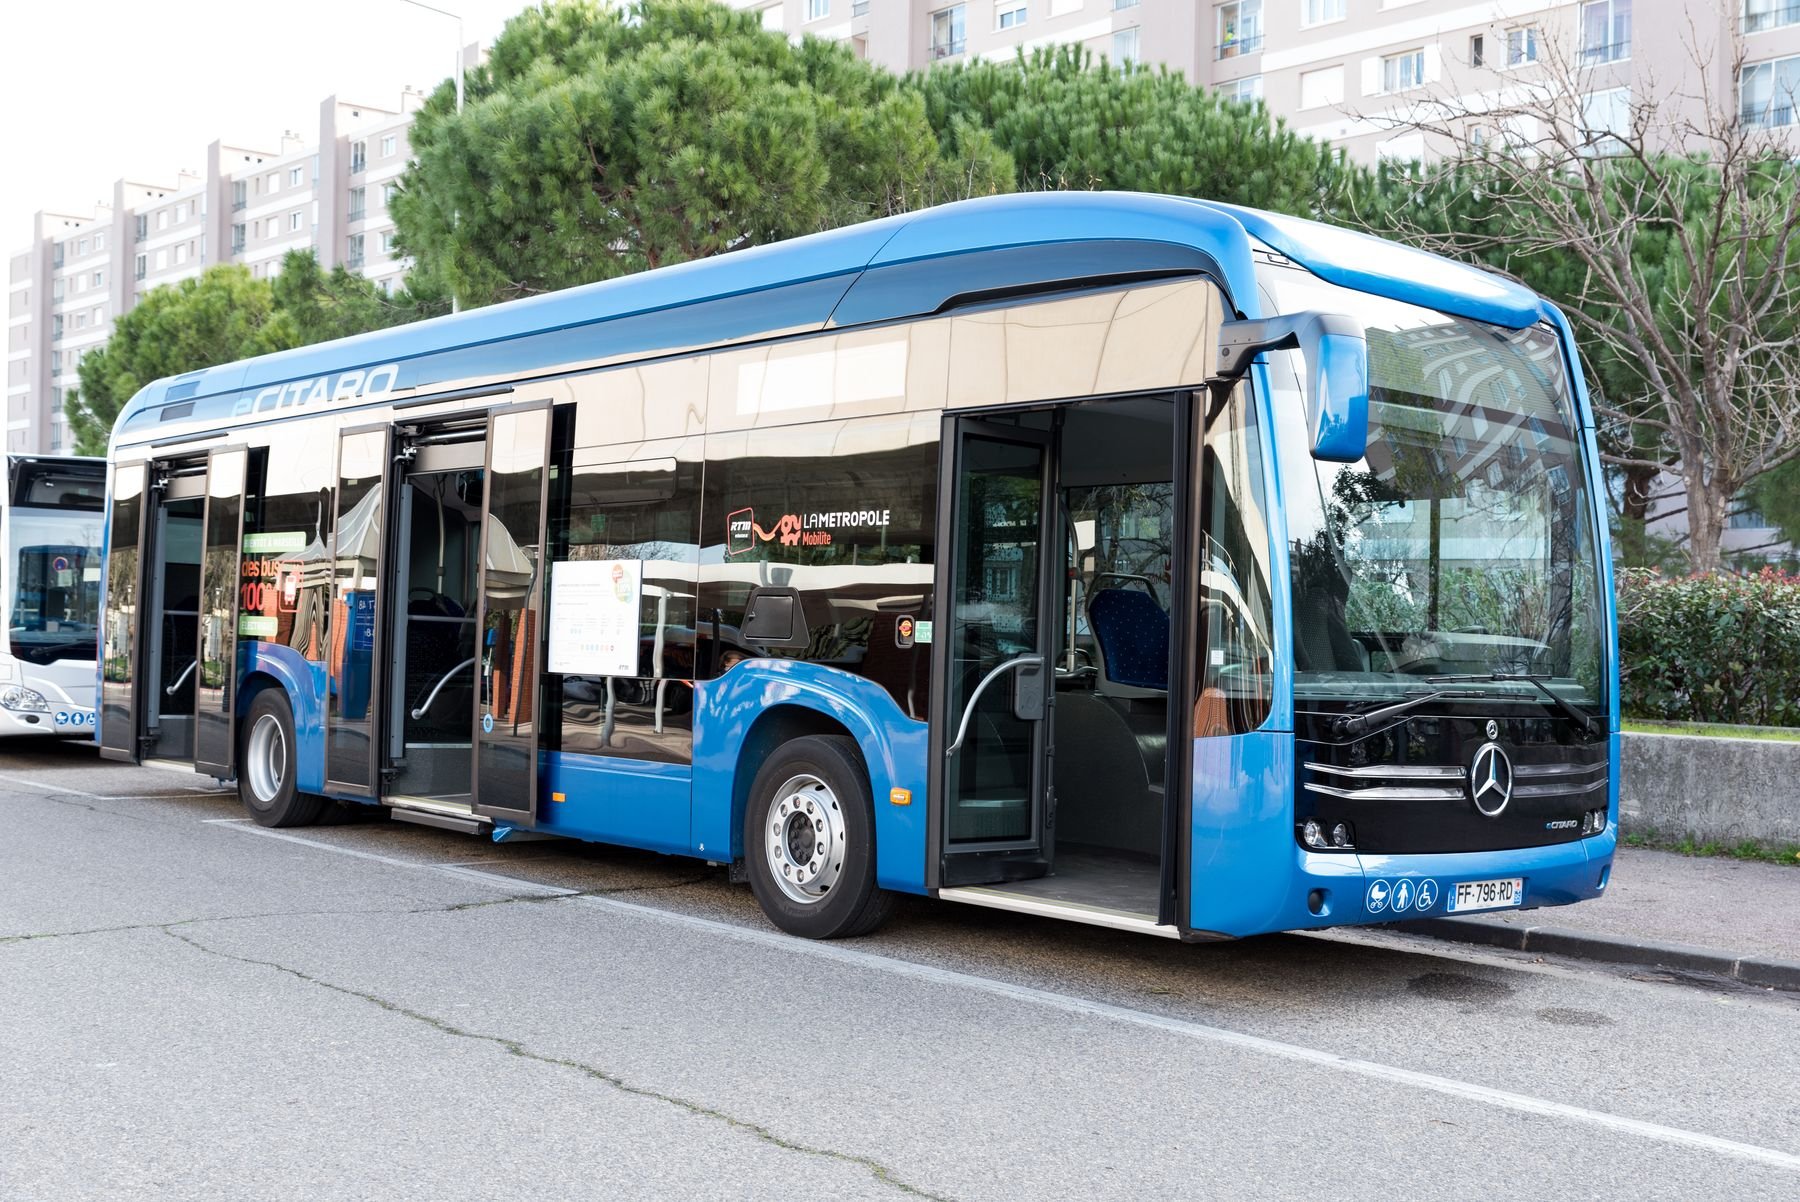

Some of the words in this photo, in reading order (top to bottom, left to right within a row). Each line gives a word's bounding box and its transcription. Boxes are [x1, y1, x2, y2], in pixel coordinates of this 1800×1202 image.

[231, 364, 399, 417] eCITARO
[731, 521, 751, 531] RTM
[242, 559, 260, 577] des
[262, 556, 280, 577] bus
[1546, 820, 1578, 829] eCITARO
[1457, 881, 1513, 905] FF-796-RD
